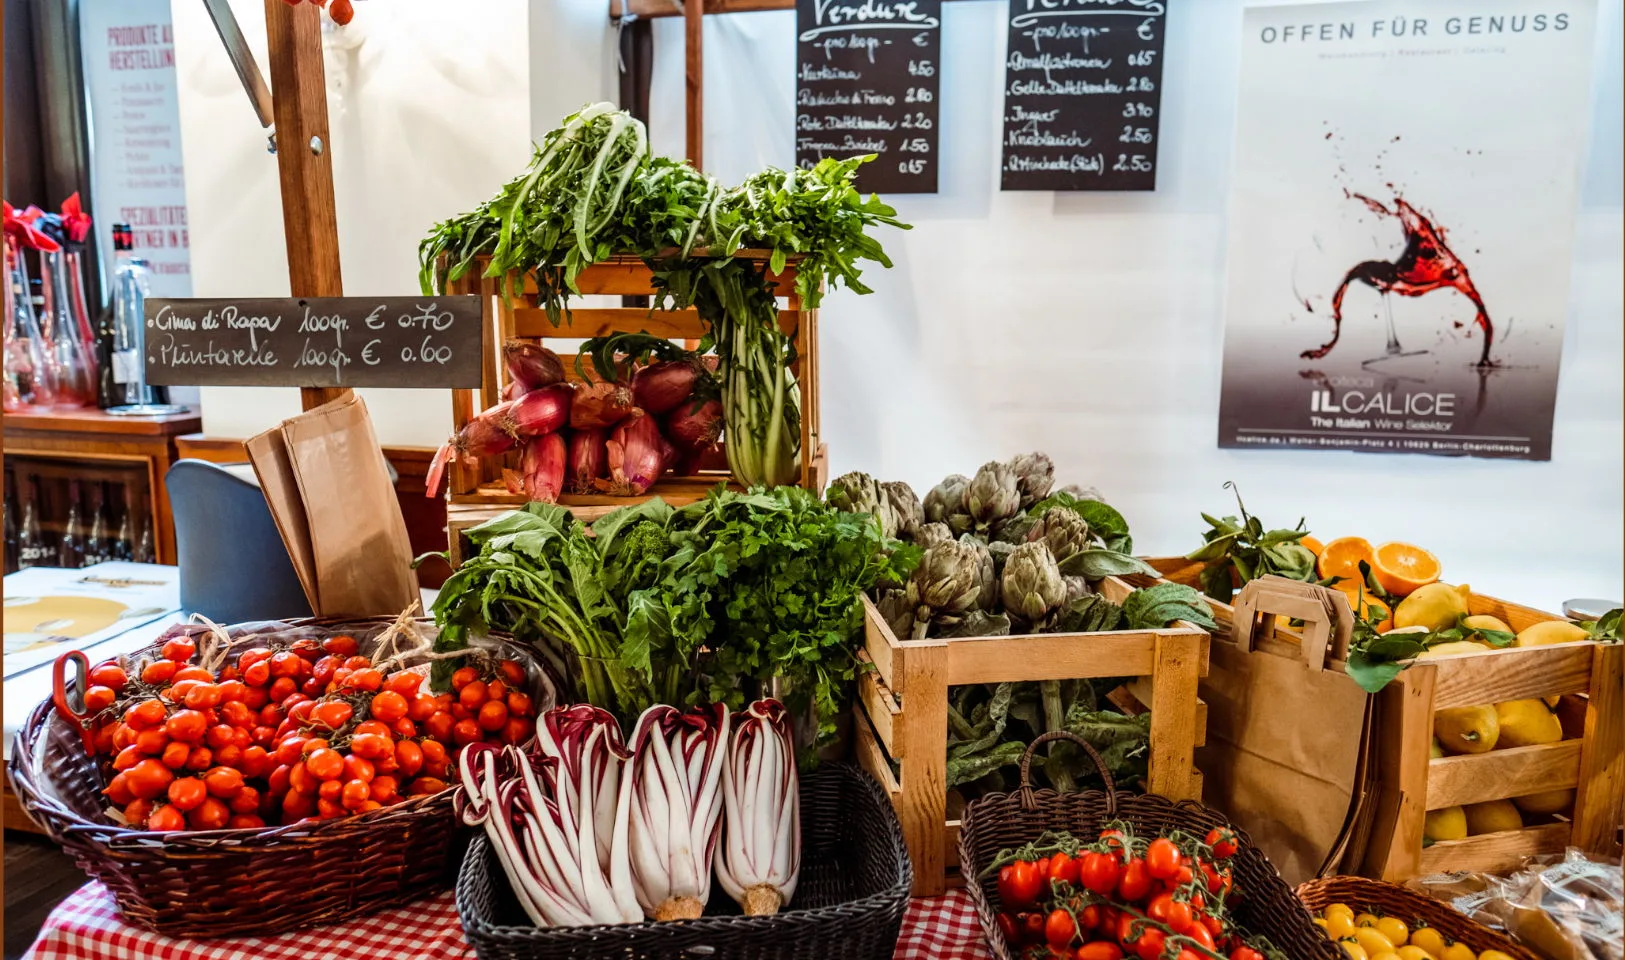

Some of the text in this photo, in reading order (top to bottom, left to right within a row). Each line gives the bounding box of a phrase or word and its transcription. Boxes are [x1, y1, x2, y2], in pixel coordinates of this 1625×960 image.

[813, 0, 928, 25] Verdure
[107, 25, 158, 47] PRODUKTE
[1137, 17, 1156, 40] €
[1261, 12, 1570, 44] OFFEN FÜR GENUSS
[912, 32, 929, 47] €
[109, 48, 176, 71] HERSTELLUN
[901, 112, 933, 129] 2.20
[899, 138, 930, 152] 1.50
[1120, 126, 1152, 143] 2.50
[1113, 154, 1152, 172] 2.50
[121, 206, 187, 226] SPEZIALITÄTE
[156, 305, 196, 331] Cima
[202, 310, 219, 329] di
[221, 306, 281, 352] Rapa
[365, 305, 387, 330] €
[398, 302, 454, 331] 0.70
[361, 339, 381, 366] €
[401, 335, 453, 364] 0.60
[1311, 416, 1333, 428] The
[1336, 417, 1371, 429] Italian
[1374, 418, 1404, 429] Wine
